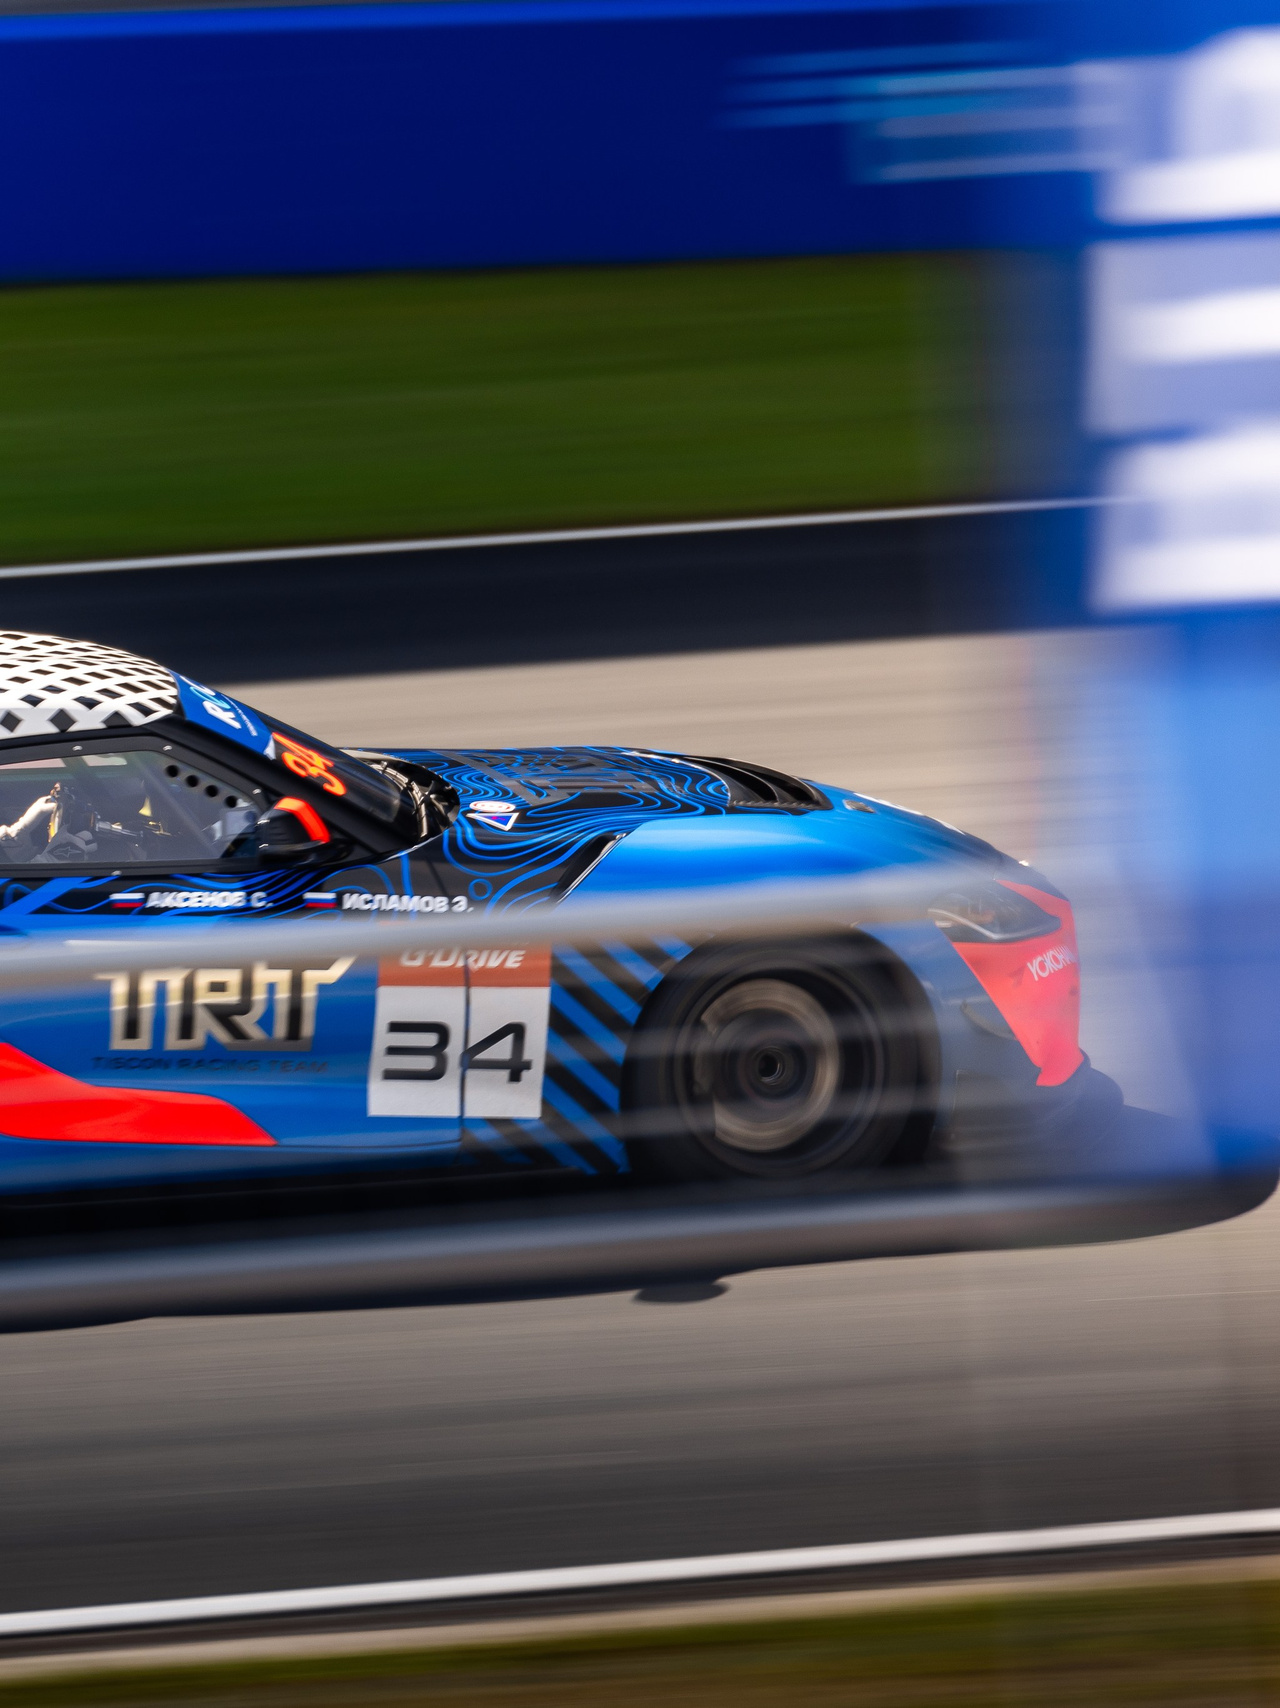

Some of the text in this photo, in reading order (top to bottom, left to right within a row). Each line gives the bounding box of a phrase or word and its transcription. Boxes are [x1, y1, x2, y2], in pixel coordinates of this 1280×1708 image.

[272, 732, 347, 796] 34
[145, 891, 274, 908] АКСЕНОВ С.
[342, 893, 449, 913] ИСЛАМОВ
[382, 1020, 532, 1084] 34
[177, 1058, 261, 1073] RACING
[268, 1059, 329, 1074] TEAM
